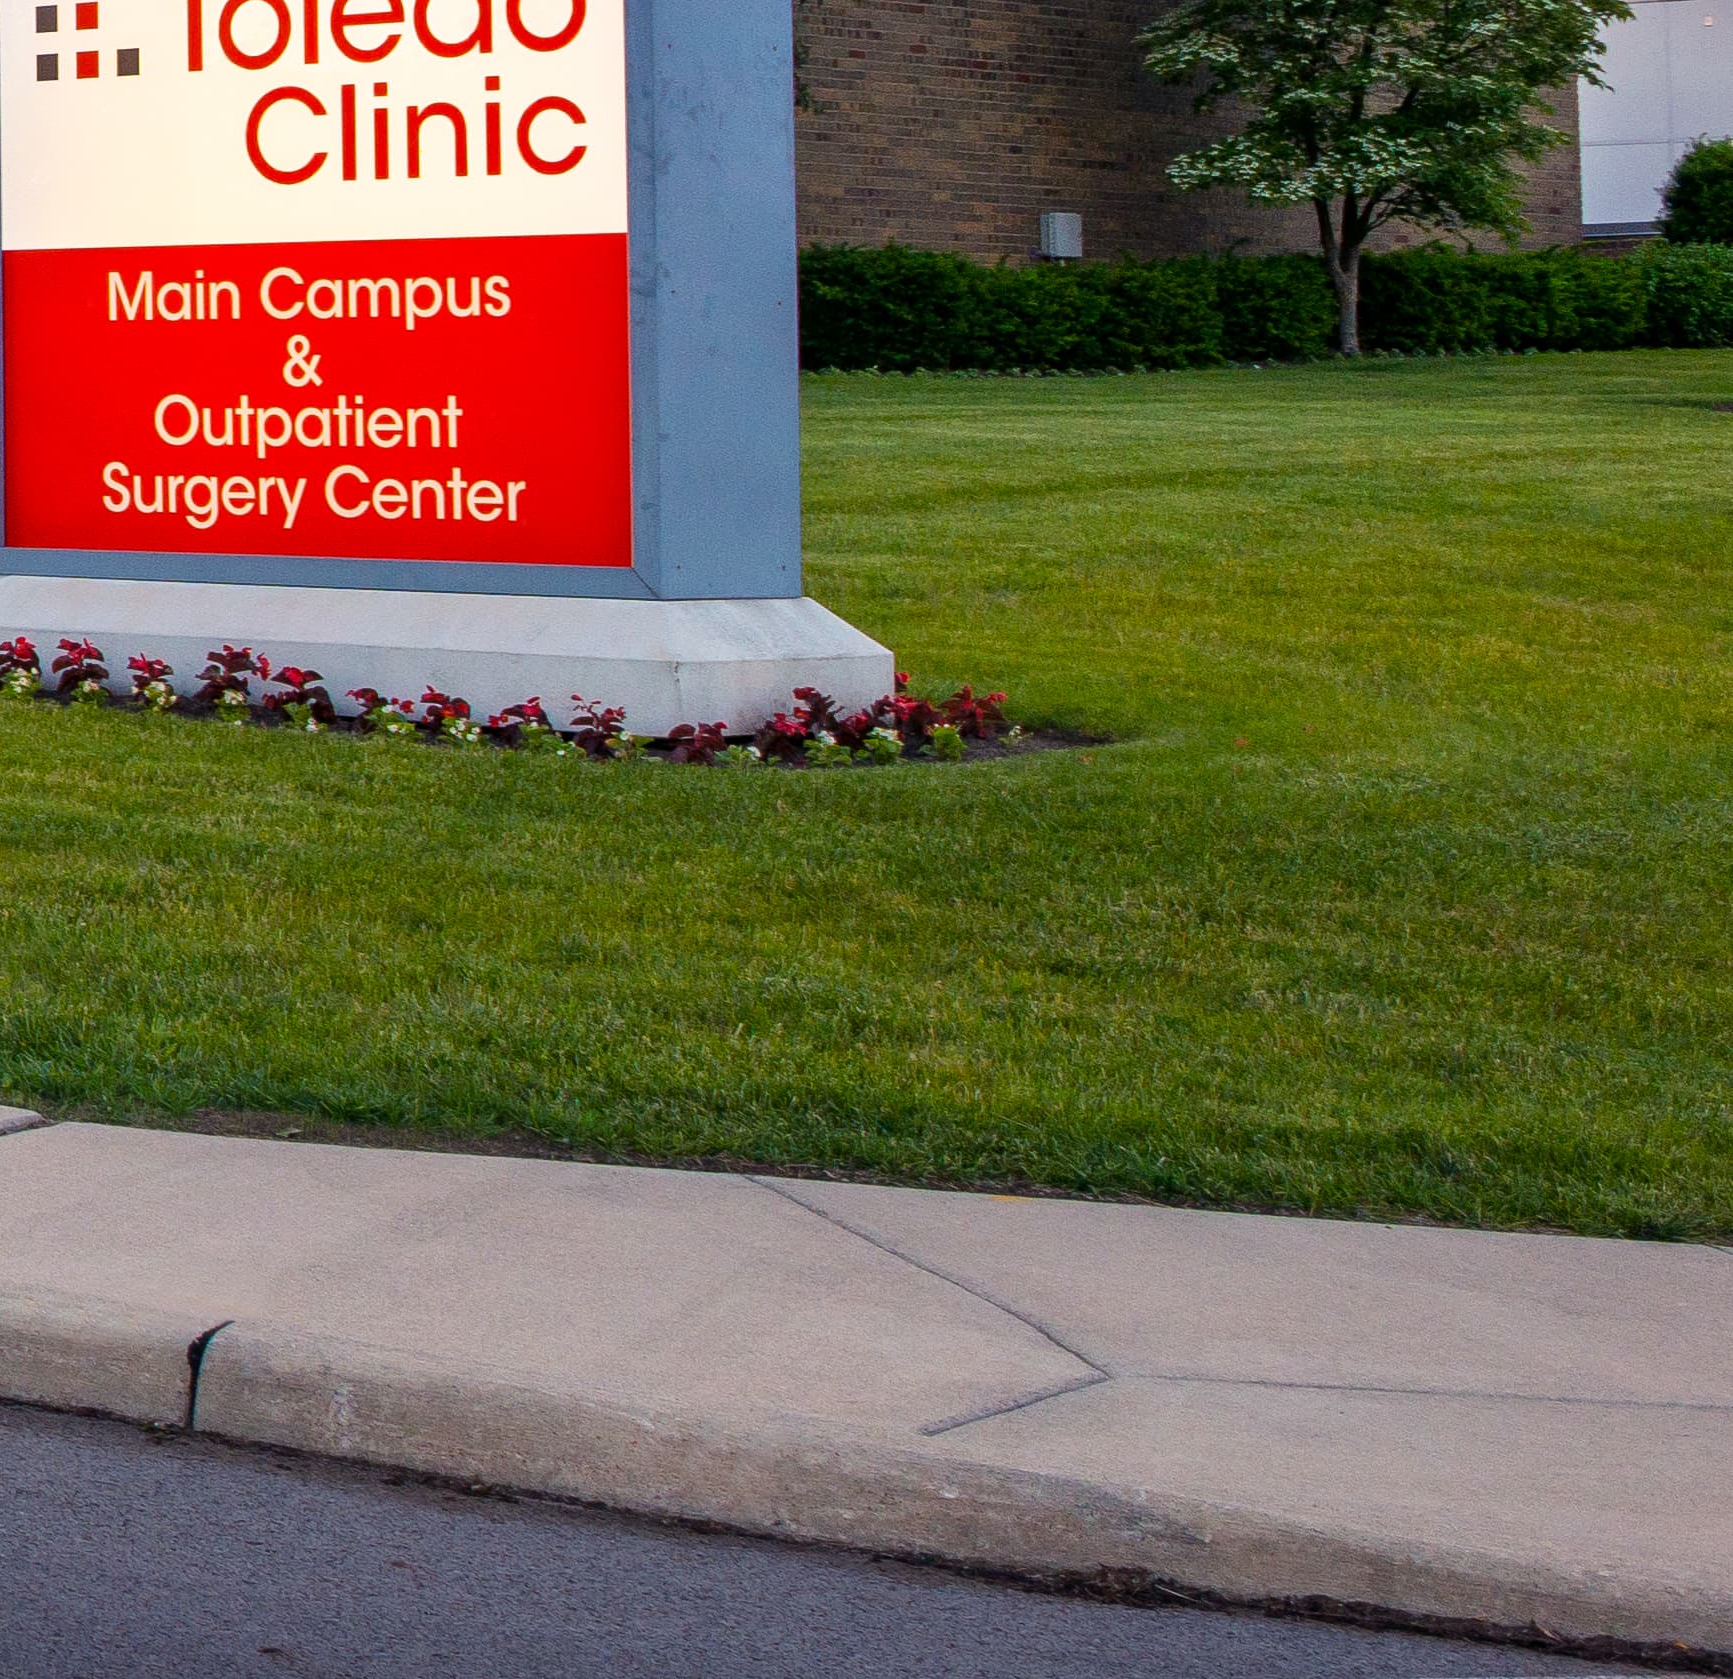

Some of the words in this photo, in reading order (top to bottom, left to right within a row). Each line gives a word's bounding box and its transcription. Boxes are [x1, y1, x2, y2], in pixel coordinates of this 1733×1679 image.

[245, 75, 589, 186] Clinic
[108, 269, 241, 321] Main
[259, 266, 511, 331] Campus
[282, 333, 323, 388] &
[154, 392, 463, 459] Outpatient
[102, 461, 307, 530] Surgery
[324, 464, 526, 522] Center
